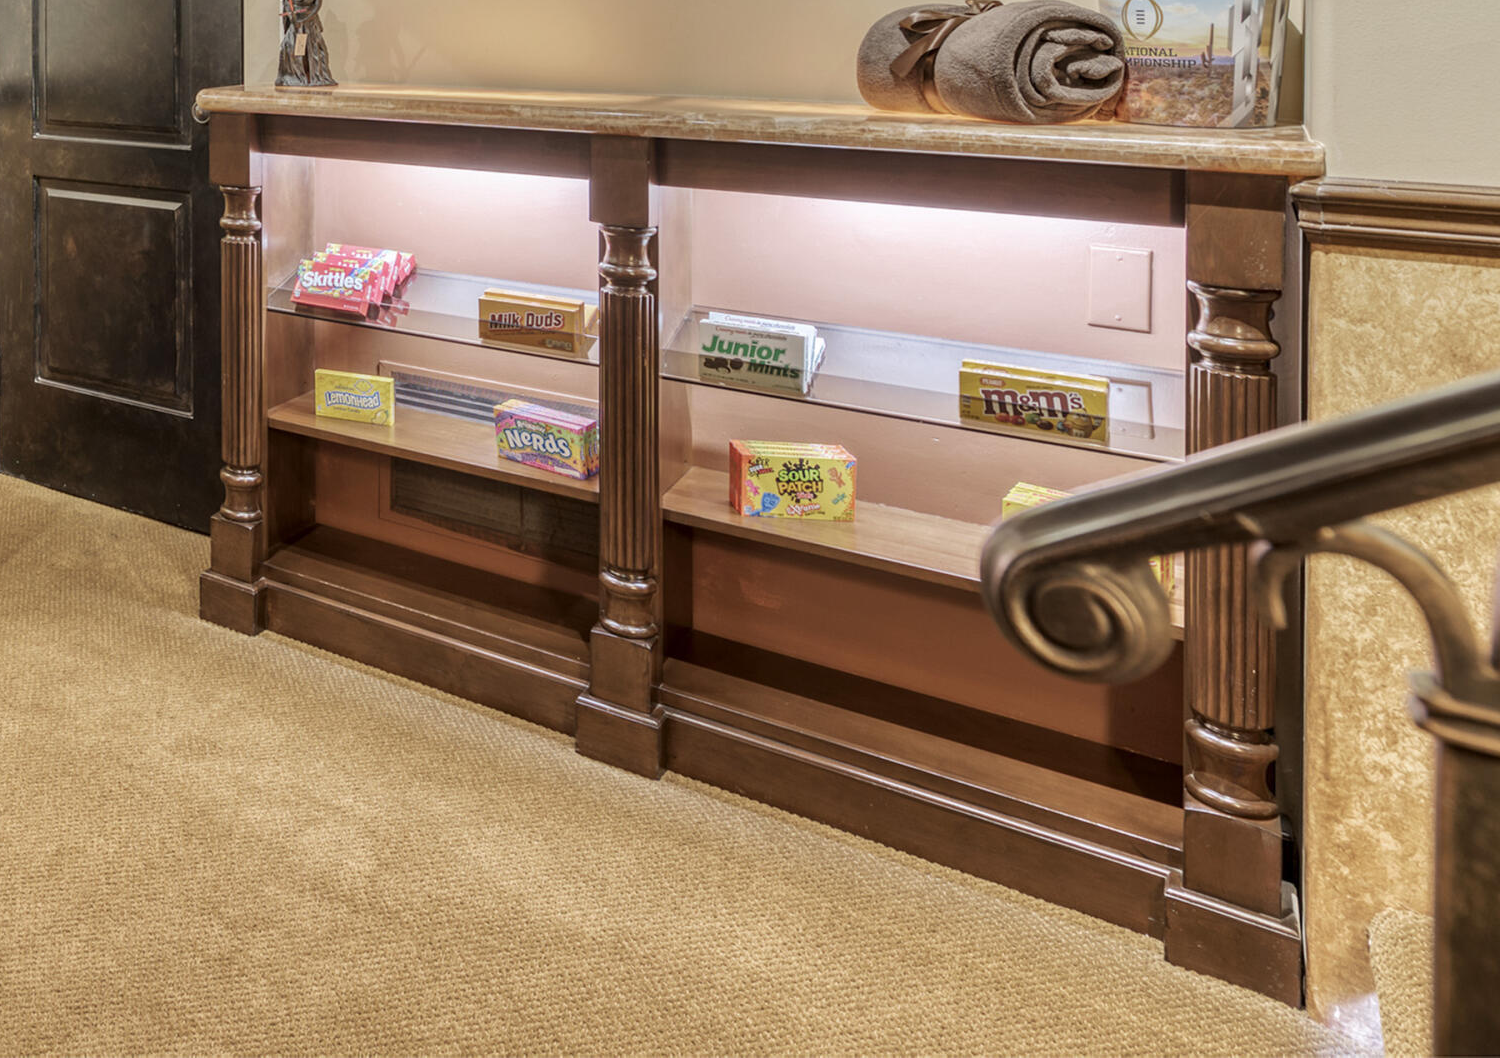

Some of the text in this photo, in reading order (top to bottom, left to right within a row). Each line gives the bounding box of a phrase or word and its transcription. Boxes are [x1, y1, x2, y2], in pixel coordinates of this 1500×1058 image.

[301, 269, 364, 291] Skittles
[488, 310, 565, 331] Milk Duds
[701, 334, 787, 362] Junior
[747, 359, 801, 380] Mints
[778, 468, 820, 482] SOUR
[778, 481, 823, 495] PATCH
